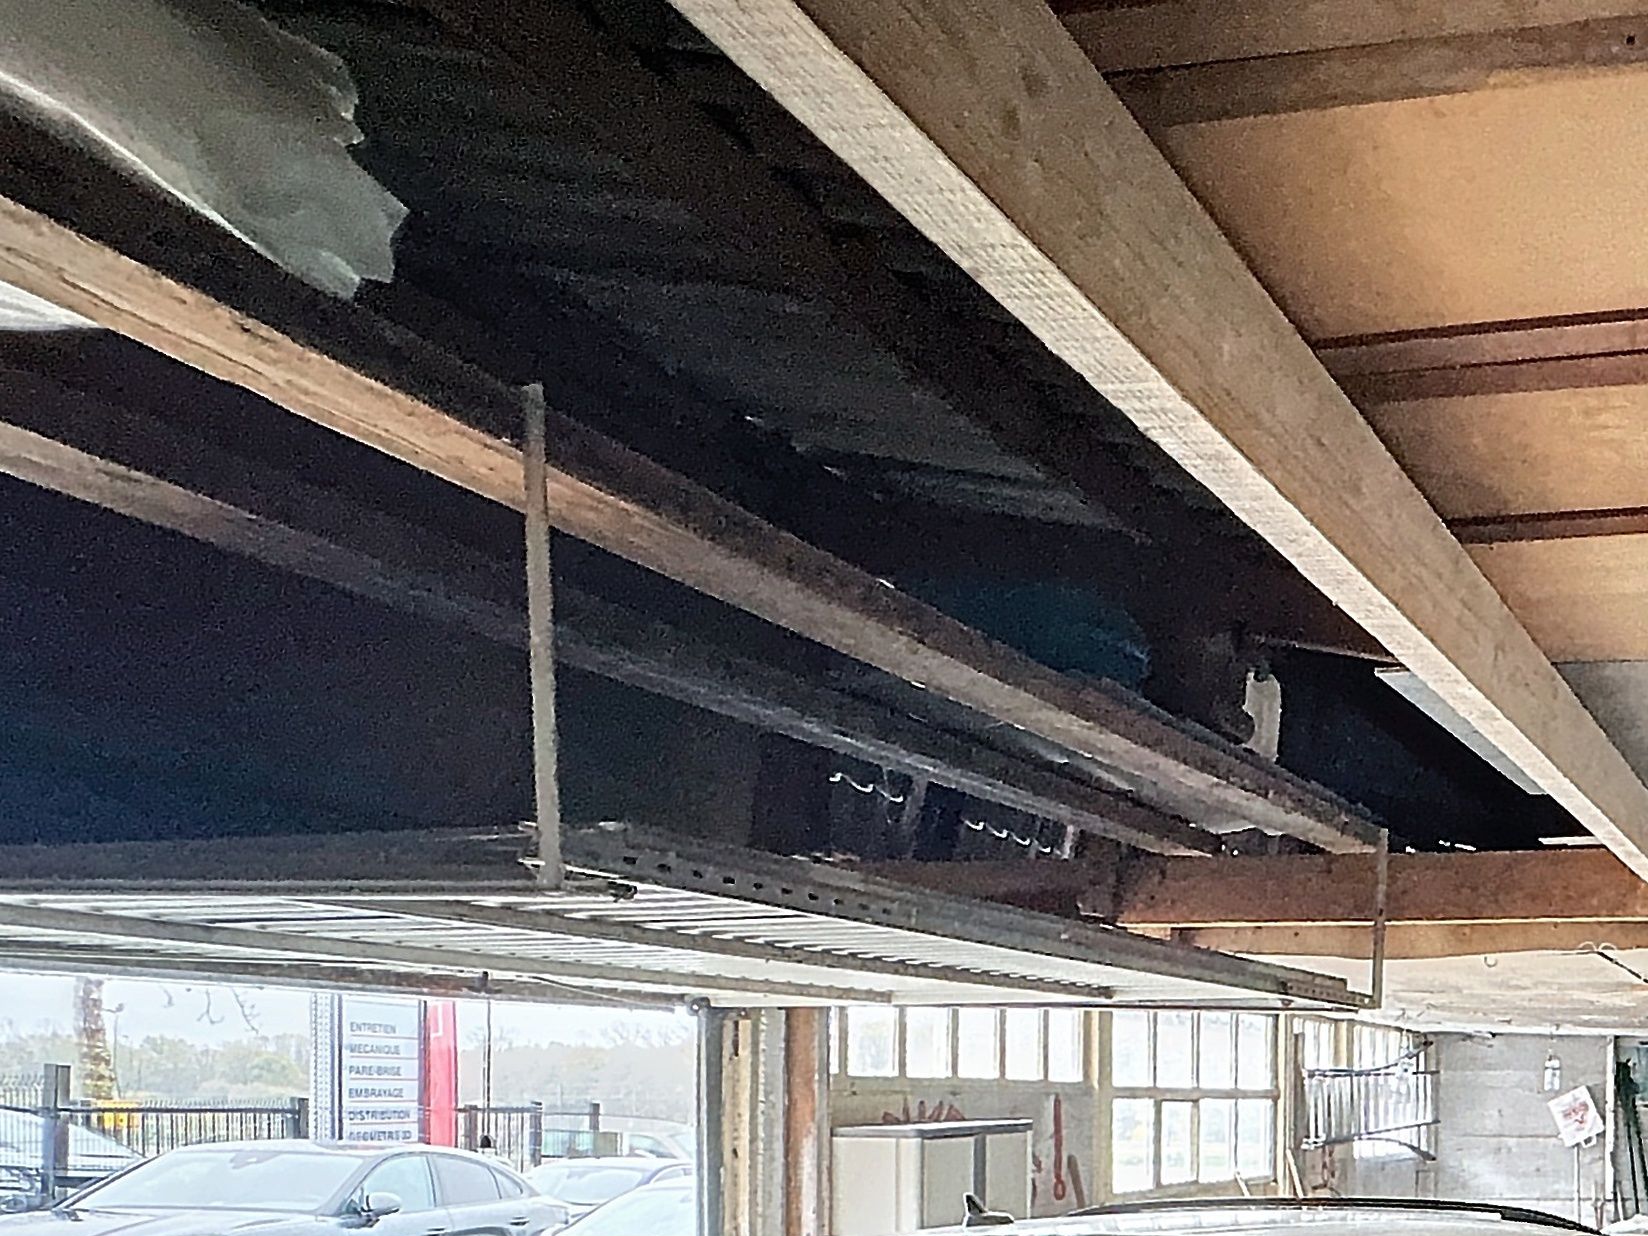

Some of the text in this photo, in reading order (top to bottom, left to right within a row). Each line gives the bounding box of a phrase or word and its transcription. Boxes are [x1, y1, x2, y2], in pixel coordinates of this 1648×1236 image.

[350, 1021, 397, 1034] ENTRETIEN
[348, 1065, 402, 1077] PARE-BRISE
[348, 1087, 404, 1099] EMBRAYAGE
[347, 1109, 411, 1121] DISTRIBUTION
